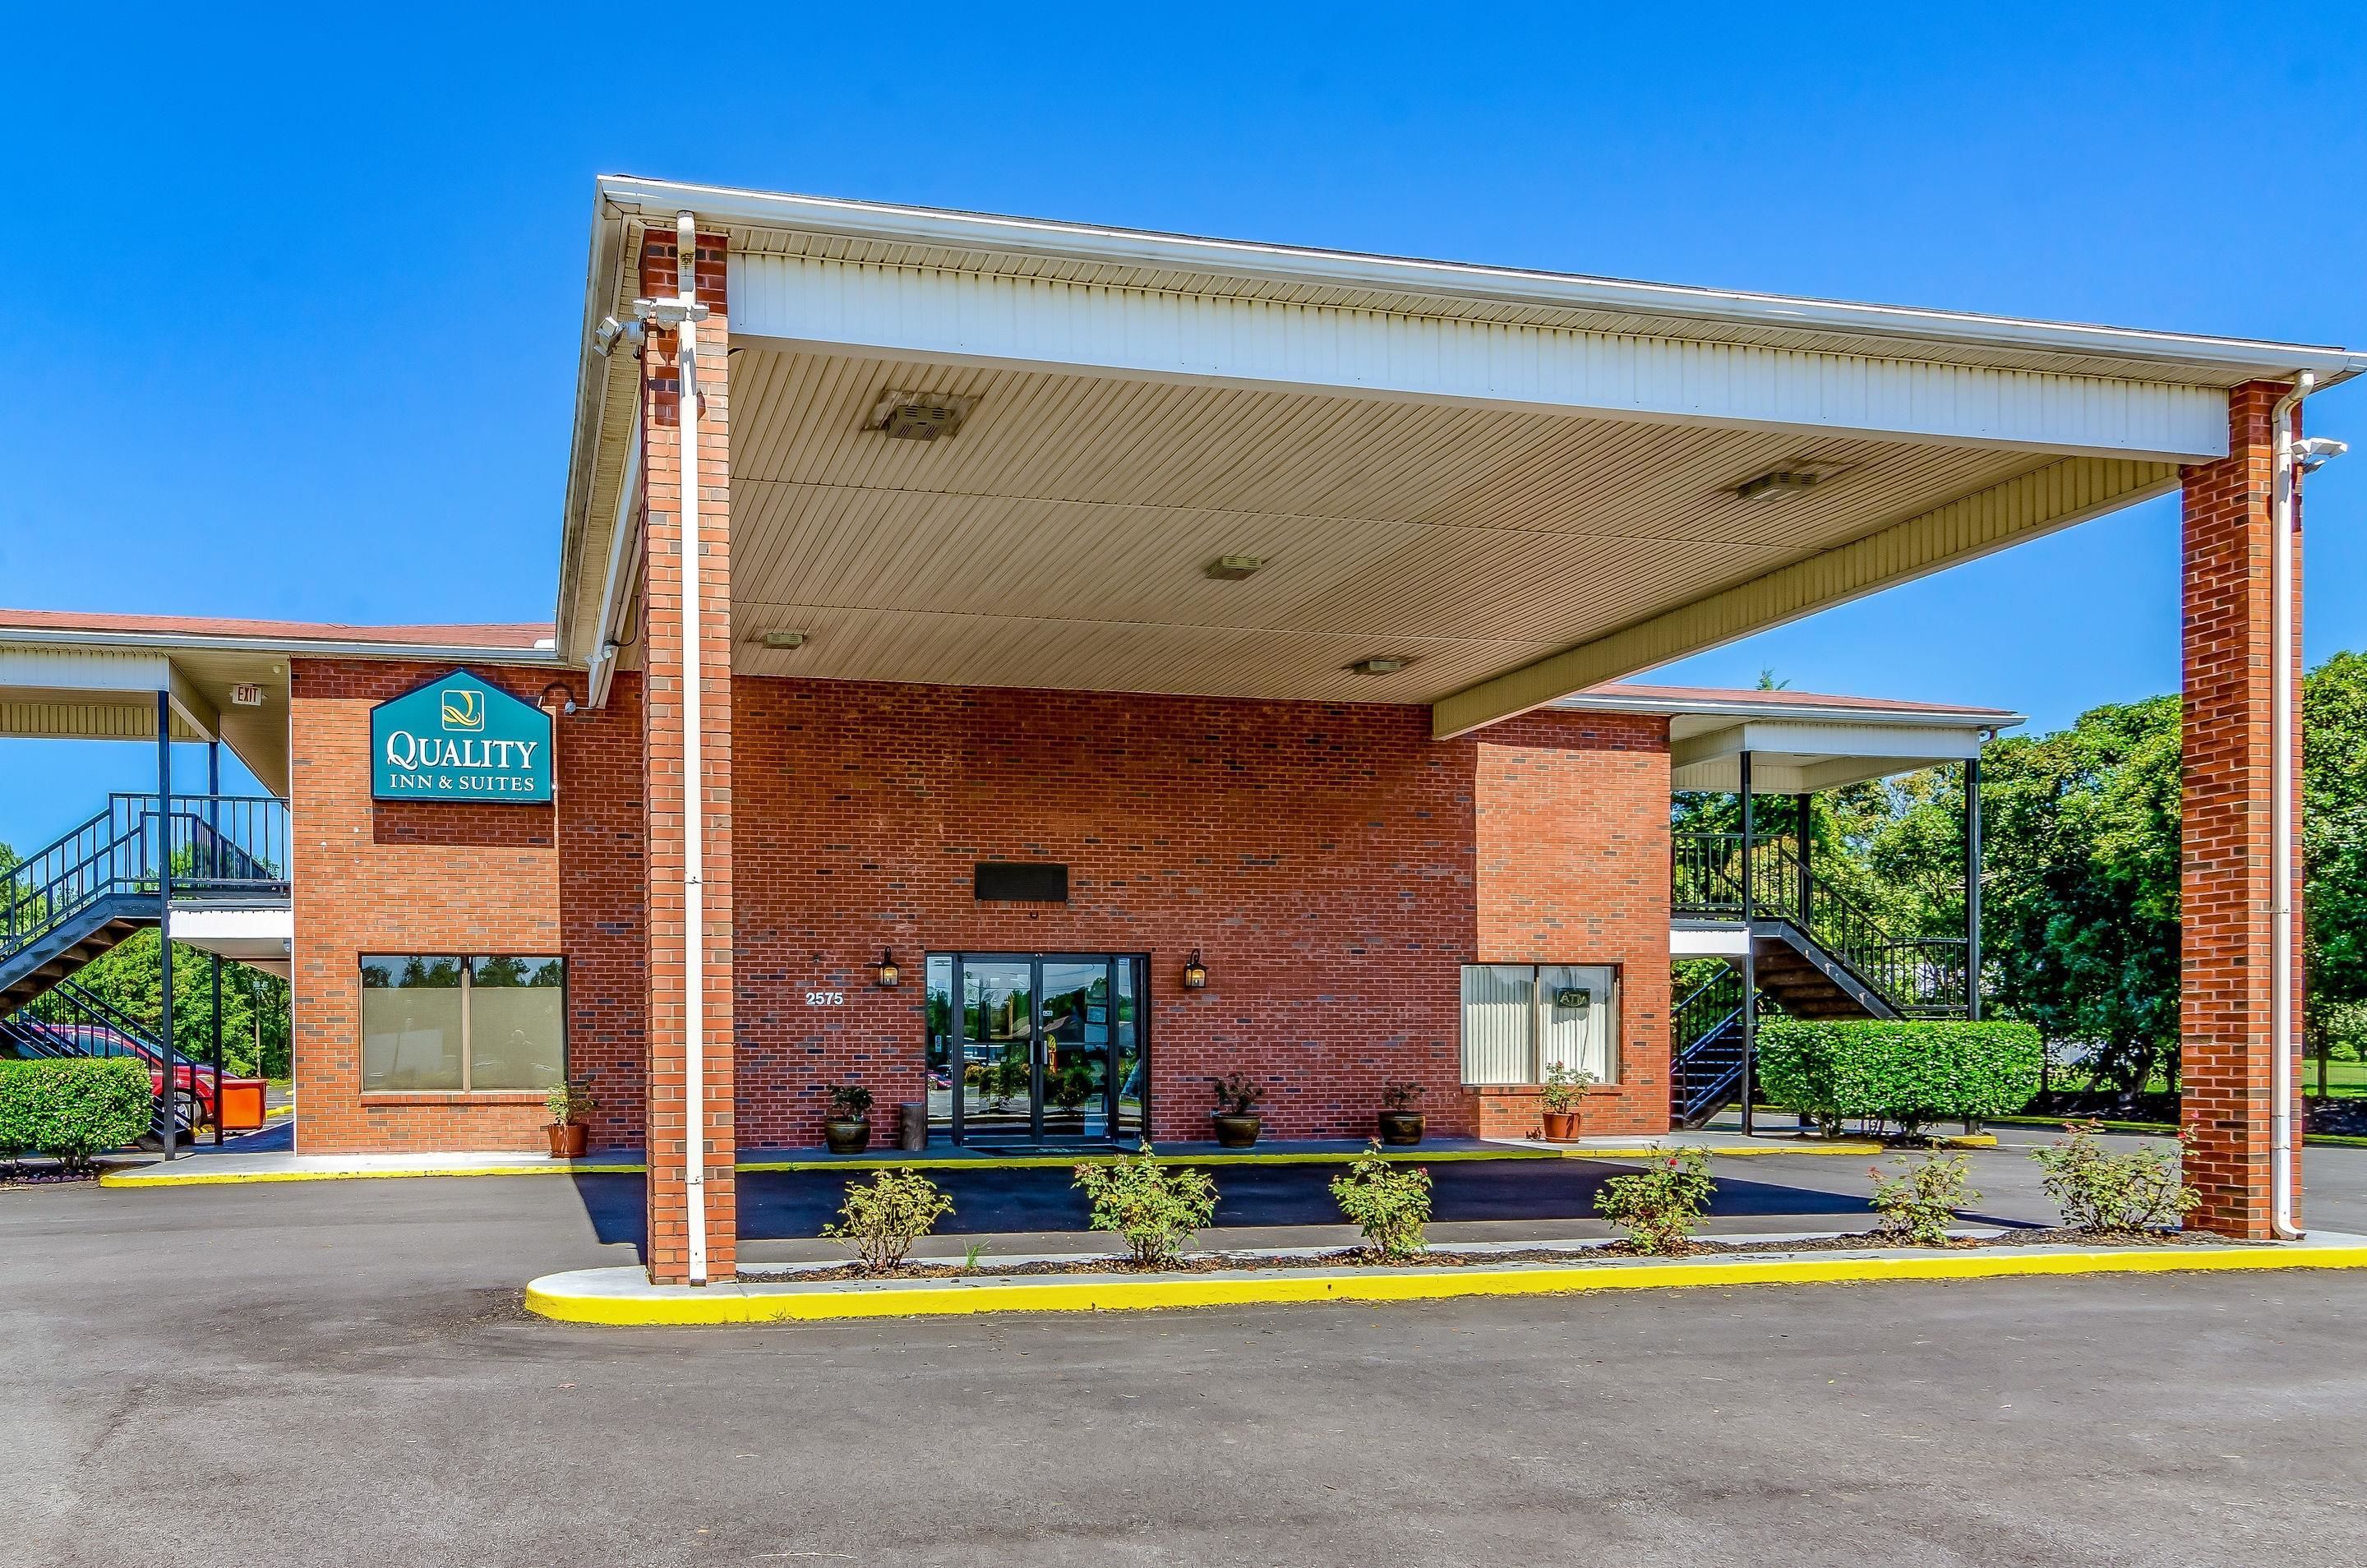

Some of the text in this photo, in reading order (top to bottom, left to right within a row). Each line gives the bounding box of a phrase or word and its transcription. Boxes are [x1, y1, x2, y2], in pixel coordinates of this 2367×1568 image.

[238, 686, 258, 703] EXIT
[386, 731, 538, 771] QUALITY
[390, 774, 534, 791] INN & SUITES
[805, 992, 843, 1005] 2575
